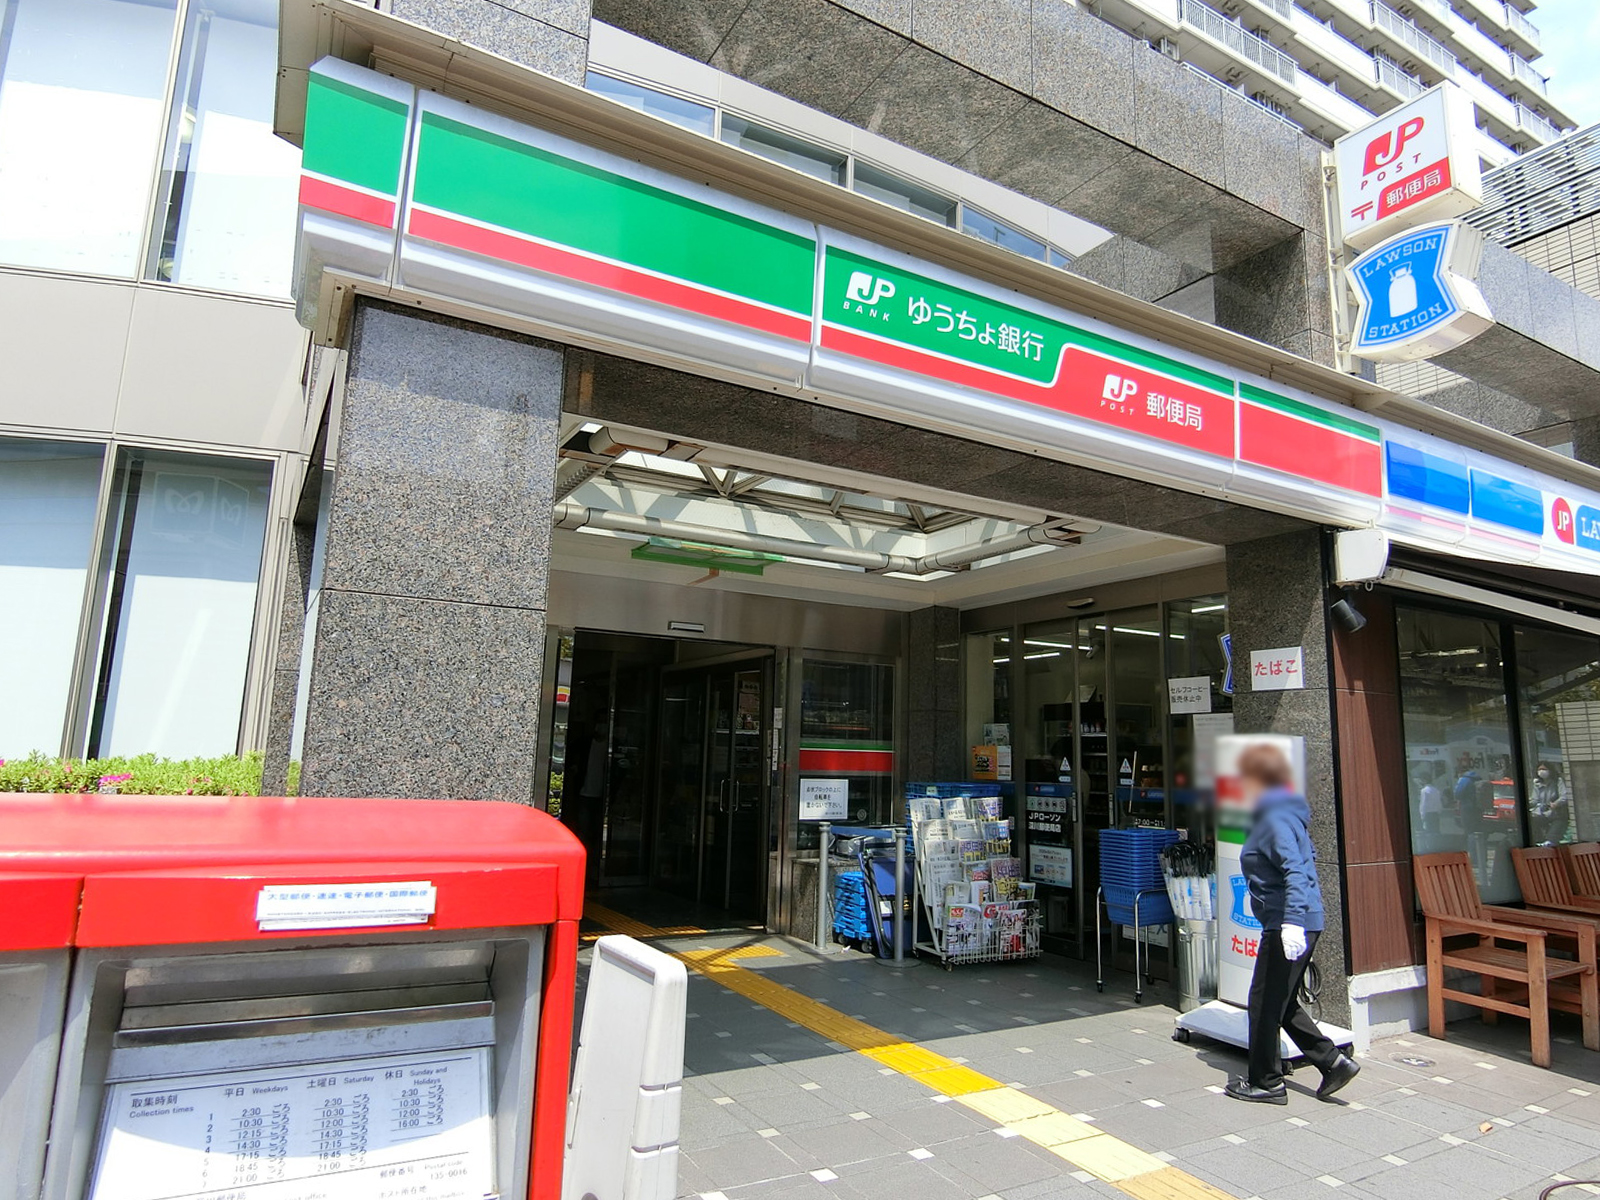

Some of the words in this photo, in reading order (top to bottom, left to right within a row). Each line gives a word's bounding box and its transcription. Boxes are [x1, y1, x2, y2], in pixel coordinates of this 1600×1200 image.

[1363, 116, 1425, 177] JP
[1361, 153, 1422, 190] POST
[1385, 170, 1441, 207] 郵便局
[1364, 236, 1438, 278] LAWSON
[846, 271, 896, 305] JP
[843, 301, 891, 322] BANK
[1368, 303, 1443, 338] STATION
[908, 296, 1044, 362] ゆうちょ銀行
[1102, 374, 1138, 403] JP
[1100, 400, 1136, 417] POST
[1146, 392, 1203, 432] 郵便局
[1557, 510, 1570, 532] JP
[1580, 516, 1600, 541] LA
[1254, 659, 1298, 677] たばこ
[1232, 935, 1258, 957] たば
[385, 1070, 403, 1080] 休日
[410, 1068, 434, 1077] Sunday
[307, 1077, 337, 1089] 土曜日
[344, 1075, 374, 1085] Saturday
[414, 1077, 441, 1086] Holidays
[225, 1088, 245, 1098] 平日
[252, 1085, 289, 1095] Weekdays
[402, 1088, 419, 1097] 2:30
[132, 1095, 178, 1108] 取集時刻
[325, 1098, 343, 1107] 2:30
[400, 1098, 421, 1108] 10:30
[129, 1108, 171, 1119] Collection
[172, 1106, 194, 1115] times
[209, 1113, 214, 1121] 1
[242, 1108, 262, 1117] 2:30
[322, 1108, 344, 1117] 10:30
[399, 1109, 420, 1118] 12:00
[207, 1124, 214, 1133] 2
[239, 1119, 263, 1129] 10:30
[321, 1119, 343, 1128] 12:00
[399, 1118, 420, 1128] 16:00
[206, 1135, 212, 1144] 3
[238, 1129, 262, 1139] 12:15
[320, 1129, 343, 1139] 14:30
[237, 1140, 261, 1150] 14:30
[319, 1140, 342, 1149] 17:15
[236, 1152, 260, 1161] 17:15
[318, 1150, 341, 1160] 18:45
